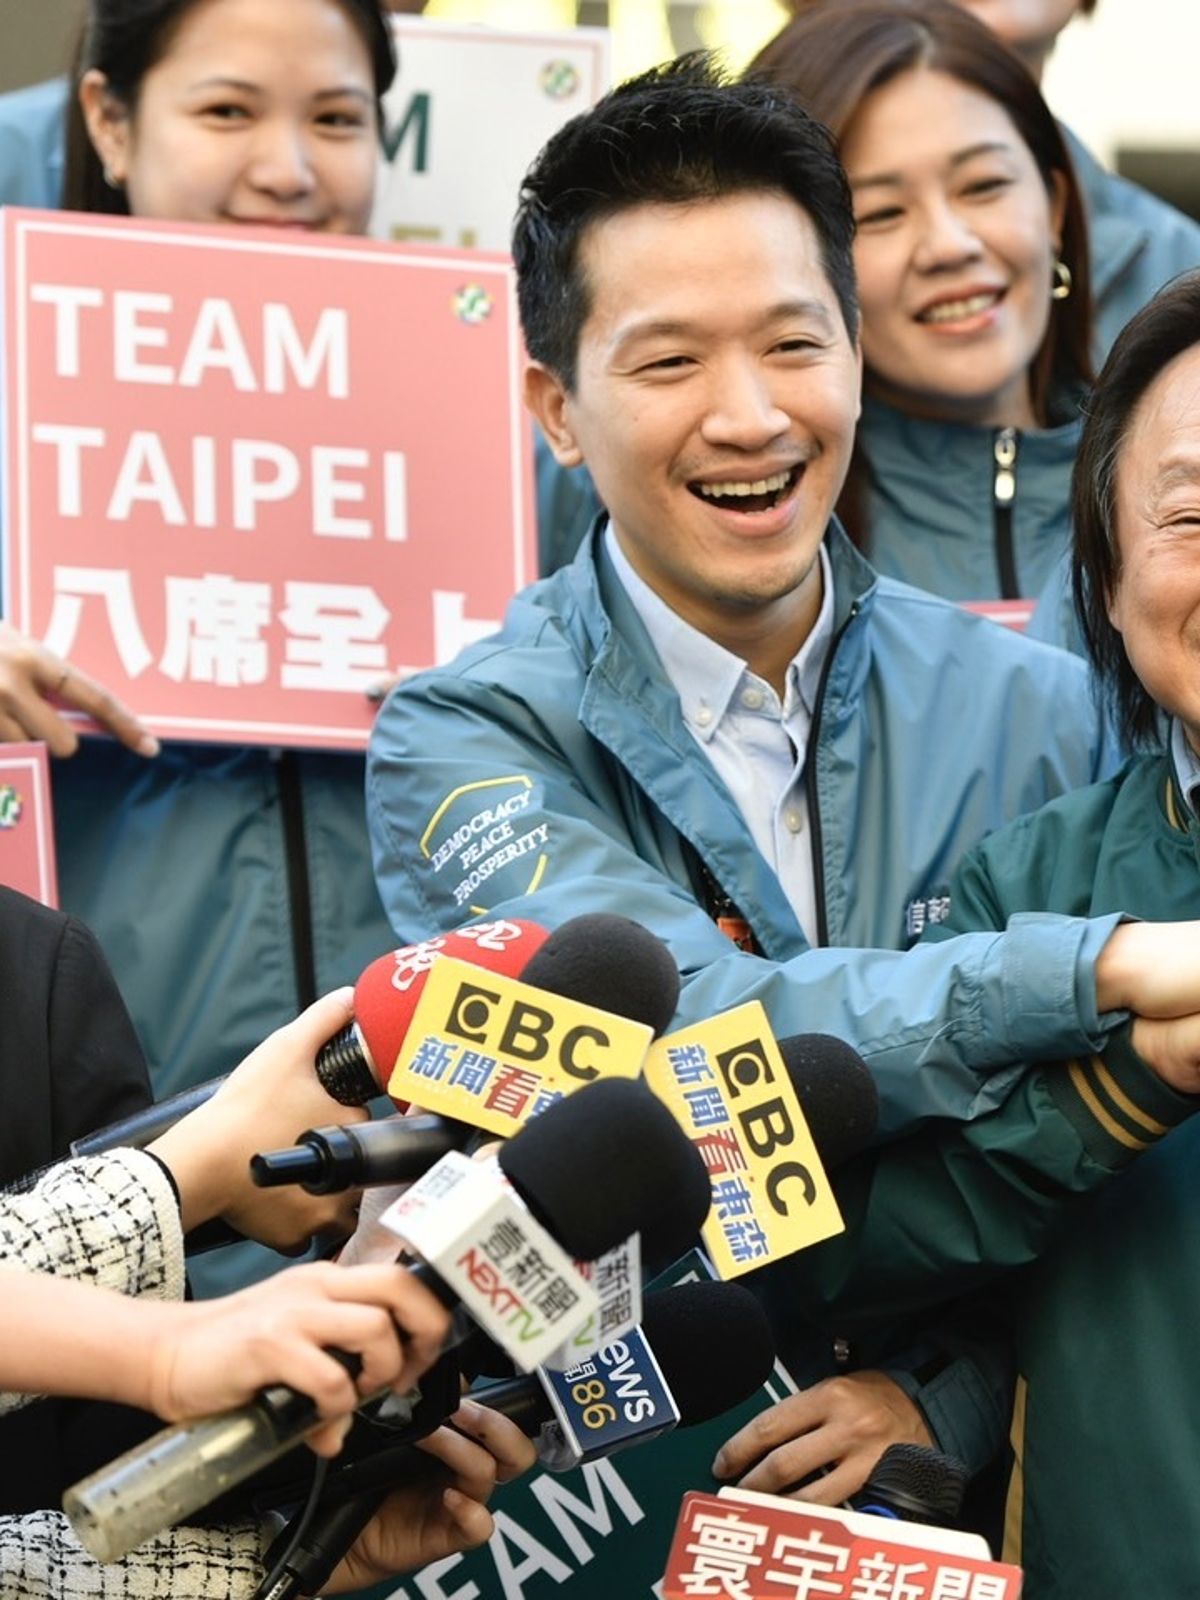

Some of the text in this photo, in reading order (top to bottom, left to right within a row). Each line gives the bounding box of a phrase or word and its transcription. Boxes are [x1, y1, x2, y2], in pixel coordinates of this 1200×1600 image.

[30, 283, 350, 399] TEAM
[32, 424, 409, 542] TAIPEI
[431, 790, 530, 872] DEMOCRACY
[452, 823, 549, 906] PROSPERITY
[459, 820, 514, 870] PEACE
[667, 1044, 769, 1263] 新聞看東森
[480, 1218, 580, 1326] 壹新聞
[597, 1246, 633, 1335] 新聞
[599, 1338, 656, 1423] ews
[384, 1455, 646, 1600] AM
